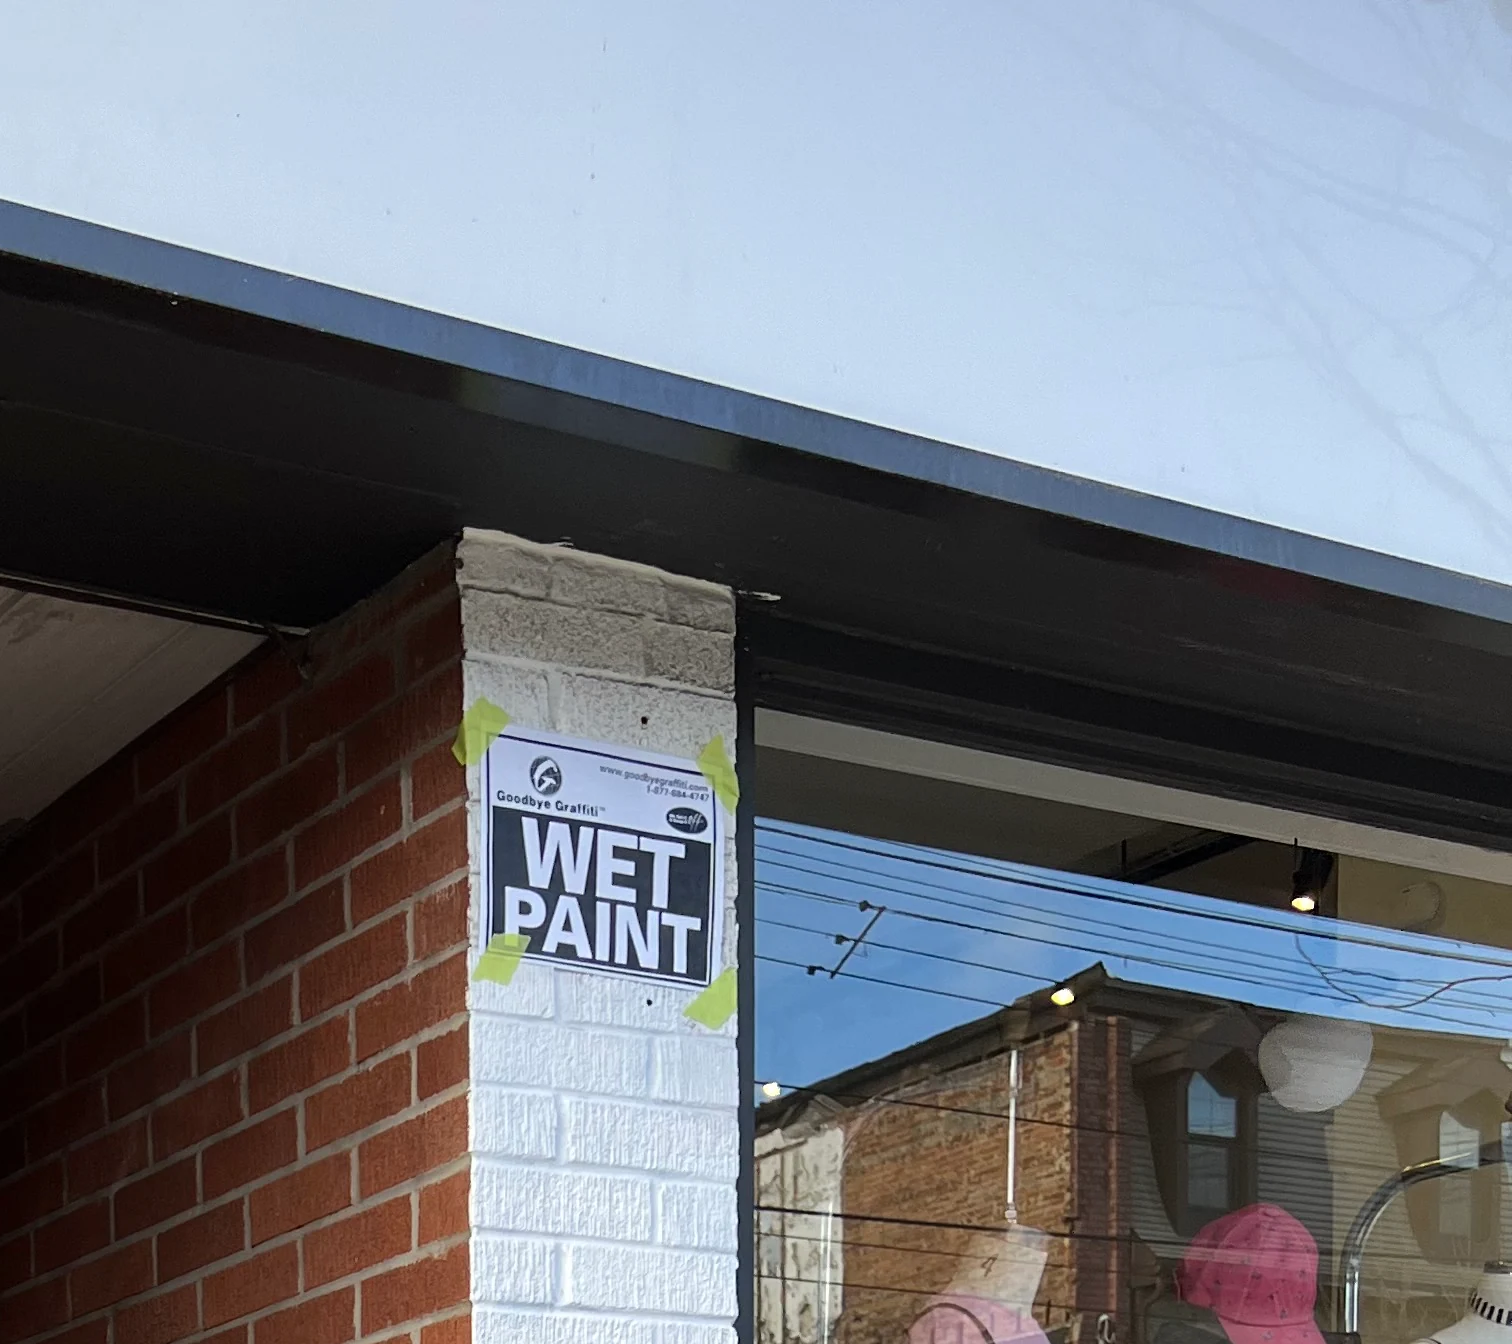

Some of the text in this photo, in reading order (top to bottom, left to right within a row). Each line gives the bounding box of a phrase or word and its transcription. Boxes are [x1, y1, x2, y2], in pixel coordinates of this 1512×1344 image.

[496, 790, 551, 810] Goodbye
[599, 765, 708, 792] www.goodbyegraffiti.com
[520, 816, 686, 909] WET
[504, 886, 702, 974] PAINT
